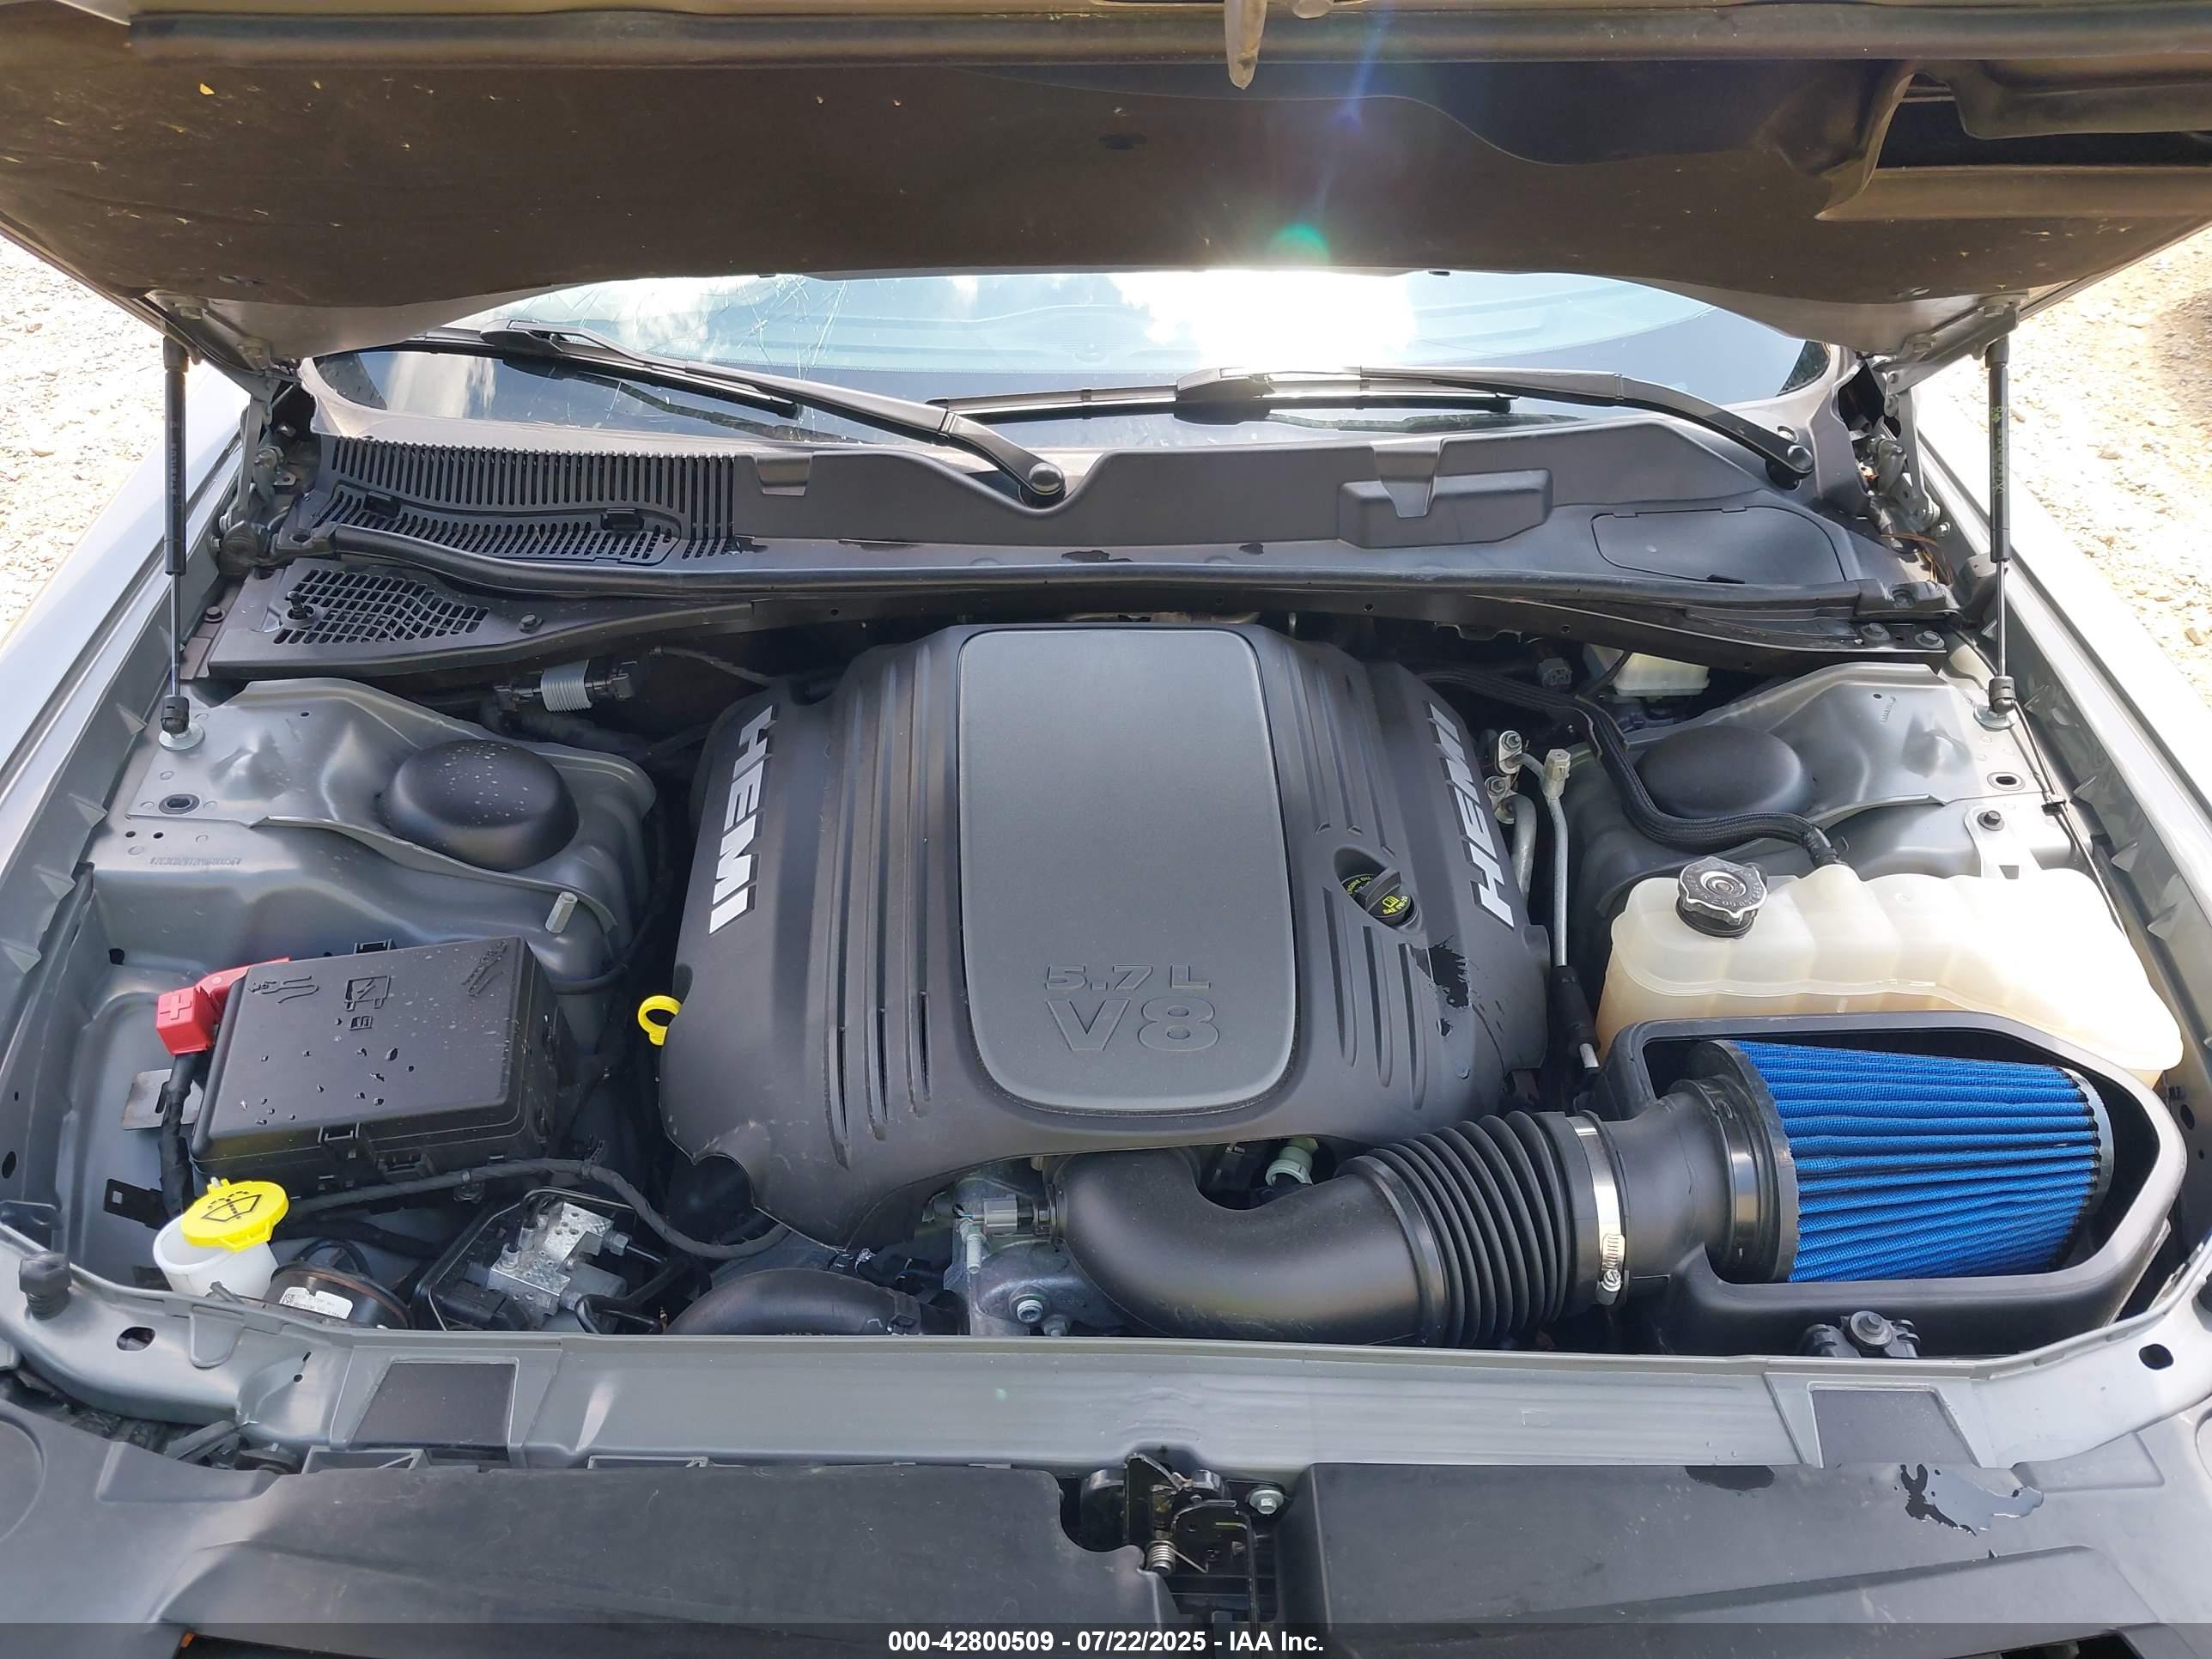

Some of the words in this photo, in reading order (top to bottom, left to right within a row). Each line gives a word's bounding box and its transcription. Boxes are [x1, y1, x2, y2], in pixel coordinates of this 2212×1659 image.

[708, 705, 773, 935] HEMI
[1429, 702, 1515, 928] HEMI
[1045, 996, 1220, 1052] V8
